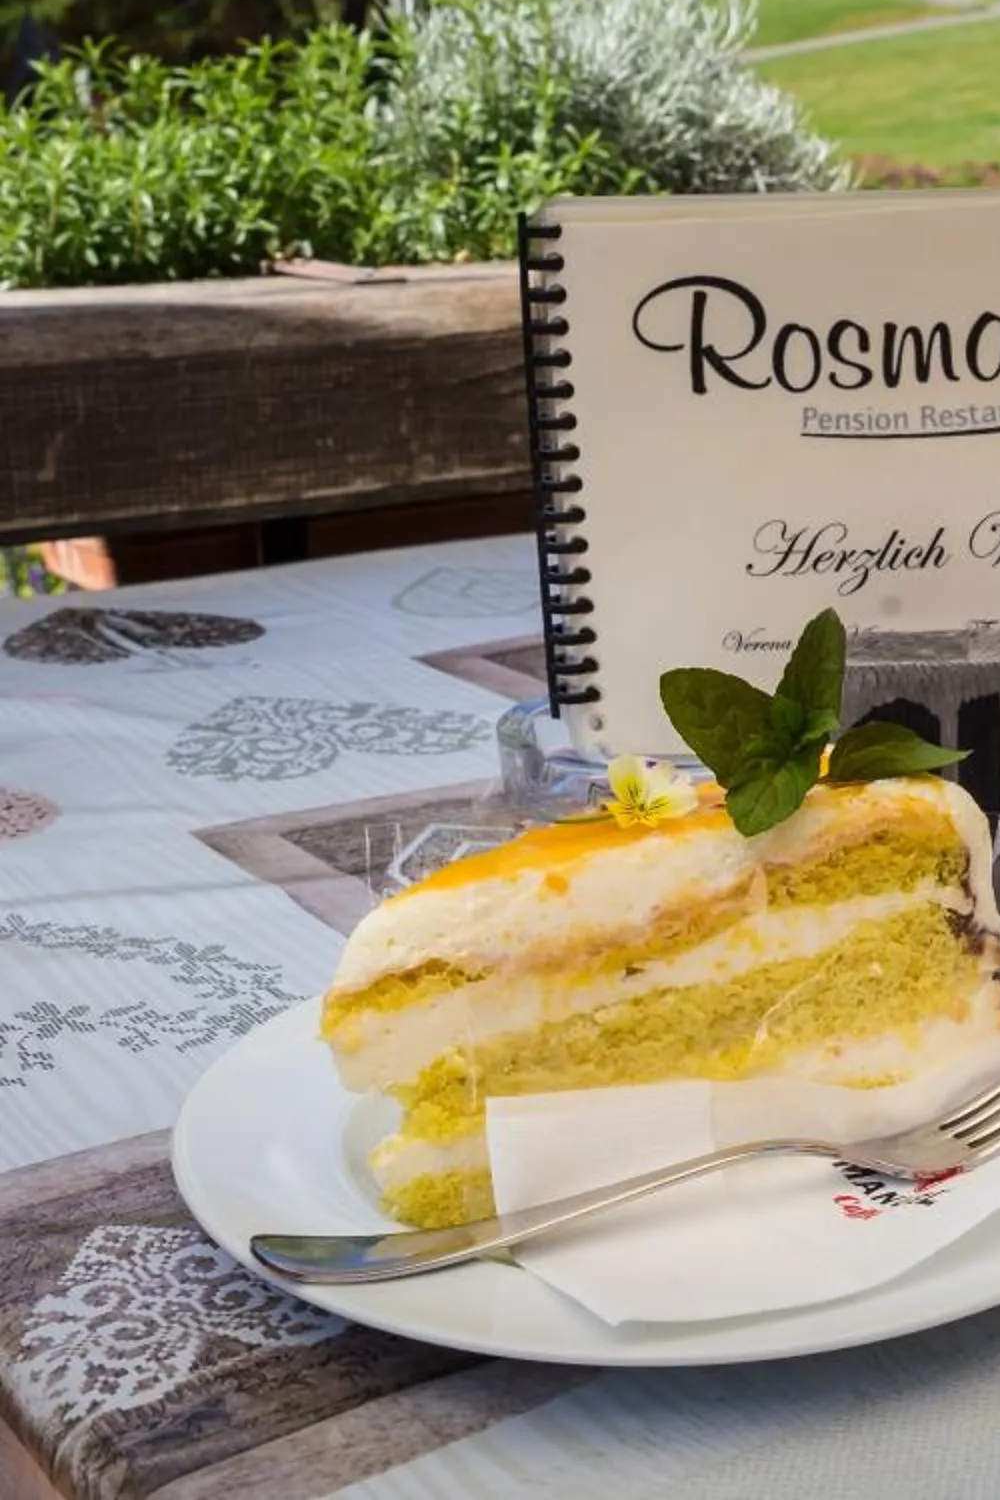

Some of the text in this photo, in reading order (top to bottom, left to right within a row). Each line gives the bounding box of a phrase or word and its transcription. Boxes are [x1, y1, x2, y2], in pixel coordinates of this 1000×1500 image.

[801, 405, 910, 432] Pension
[745, 518, 950, 597] Herzlich
[721, 626, 793, 654] Verena
